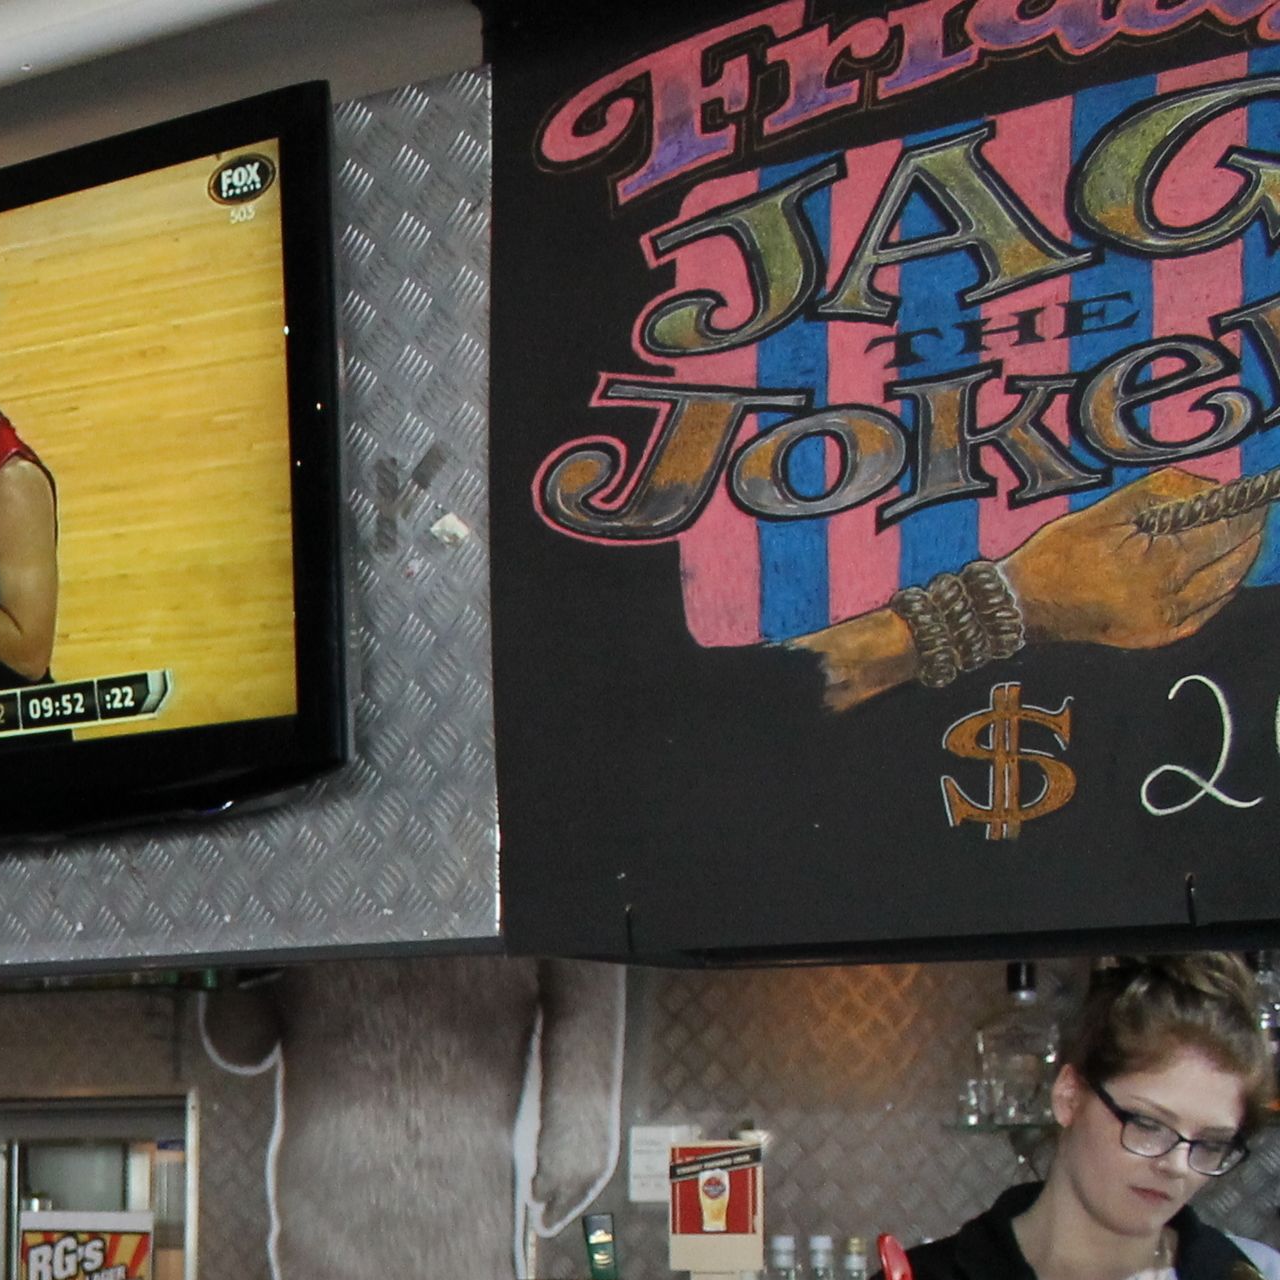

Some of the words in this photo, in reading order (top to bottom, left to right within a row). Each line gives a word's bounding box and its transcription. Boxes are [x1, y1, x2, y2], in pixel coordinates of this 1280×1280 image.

[221, 162, 260, 192] FOX
[640, 76, 1280, 353] JAG
[868, 292, 1137, 366] THE
[28, 693, 85, 719] 09:52
